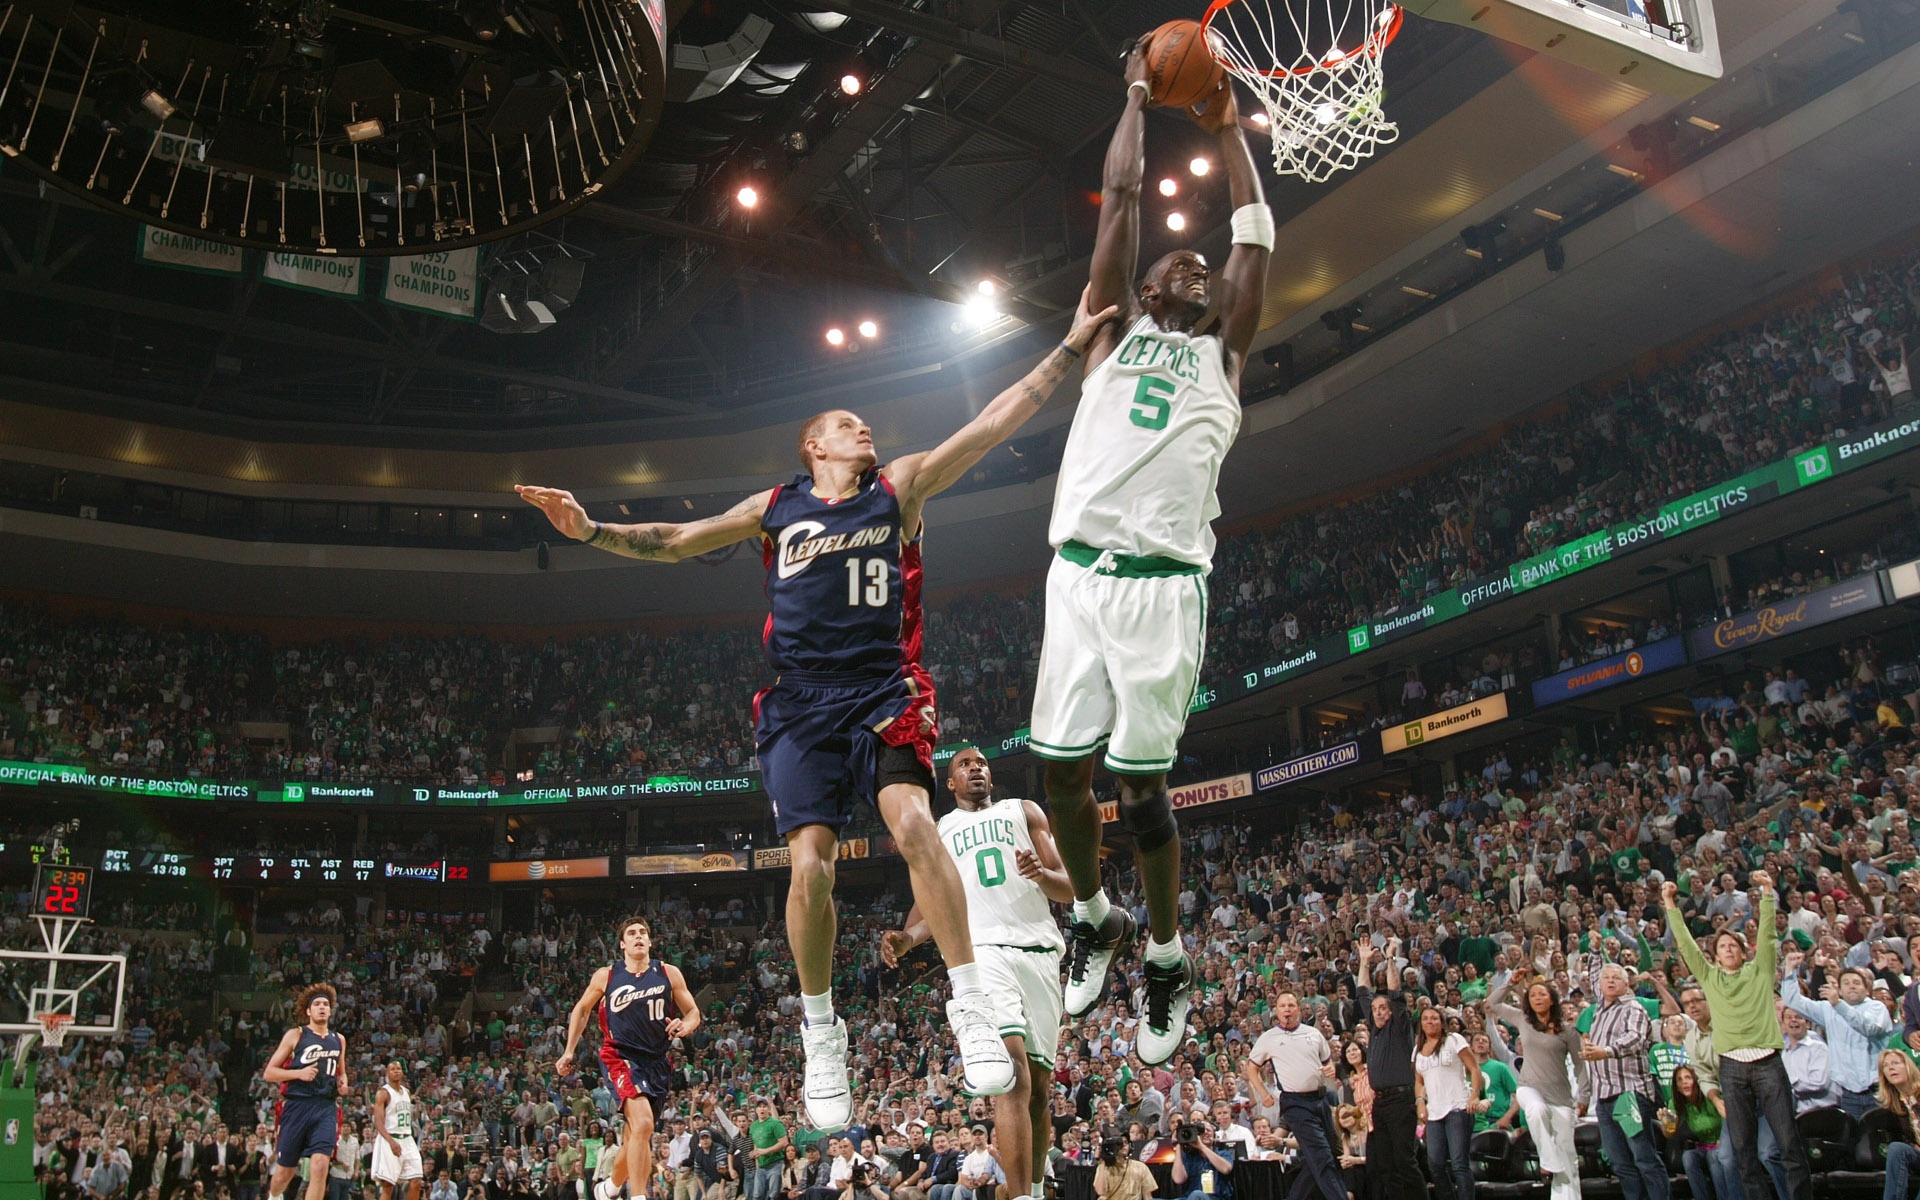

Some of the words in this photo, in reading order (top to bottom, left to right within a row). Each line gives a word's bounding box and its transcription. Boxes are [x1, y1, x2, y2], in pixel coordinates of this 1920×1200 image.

[151, 230, 236, 257] CHAMPIONS
[273, 252, 354, 279] CHAMPIONS
[410, 260, 457, 282] WORLD
[393, 273, 470, 301] CHAMPIONS
[1117, 334, 1200, 384] CELTICS
[1128, 375, 1176, 431] 5
[1798, 454, 1827, 477] TD
[1838, 419, 1920, 460] Banknor
[777, 520, 892, 580] CLEVELAND
[1461, 575, 1519, 607] OFFICIAL
[1521, 558, 1559, 586] BANK
[1562, 550, 1582, 570] OF
[1584, 536, 1613, 562] THE
[1617, 512, 1680, 548] BOSTON
[1682, 485, 1748, 524] CELTICS
[845, 557, 889, 607] 13
[1351, 629, 1367, 648] TD
[1373, 603, 1435, 637] Banknorth
[1713, 619, 1758, 649] Crown
[1746, 599, 1808, 642] Royal
[1243, 671, 1258, 689] TD
[1263, 649, 1318, 678] Banknorth
[1566, 662, 1625, 690] SYLVANIA
[1192, 690, 1217, 708] TICS
[1406, 727, 1422, 741] TD
[1427, 706, 1482, 732] Banknorth
[1001, 734, 1030, 751] OFFIC
[1259, 746, 1356, 787] MASSLOTTERY.COM
[0, 767, 57, 782] OFFICIAL
[61, 771, 97, 787] BANK
[100, 775, 117, 789] OF
[120, 777, 145, 791] THE
[148, 779, 198, 795] BOSTON
[200, 784, 249, 799] CELTICS
[285, 786, 303, 799] TD
[311, 786, 374, 798] Banknorth
[413, 788, 430, 802] TD
[438, 789, 499, 800] Banknorth
[523, 788, 573, 800] OFFICIAL
[577, 785, 608, 798] BANK
[611, 784, 627, 796] OF
[630, 782, 652, 796] THE
[655, 780, 702, 794] BOSTON
[705, 777, 750, 792] CELTICS
[1172, 783, 1229, 808] ONUTS
[952, 818, 1015, 857] CELTICS
[32, 854, 40, 864] 5
[106, 849, 129, 860] PCT
[163, 854, 179, 864] FG
[213, 857, 235, 868] 3PT
[259, 858, 275, 868] TO
[290, 859, 311, 869] STL
[320, 859, 342, 869] AST
[352, 859, 375, 869] REB
[392, 866, 439, 877] PLAYOFFS
[447, 866, 469, 879] 22
[548, 863, 569, 875] at&t
[975, 846, 1007, 888] 0
[53, 870, 86, 885] 2:39
[260, 869, 269, 880] 4
[293, 870, 301, 880] 3
[323, 870, 338, 880] 10
[355, 870, 370, 881] 17
[45, 885, 79, 913] 22
[609, 984, 666, 1013] CLEVELAND
[646, 998, 665, 1021] 10
[300, 1044, 341, 1065] CLEVELAND
[326, 1057, 337, 1077] 11
[397, 1112, 410, 1127] 20
